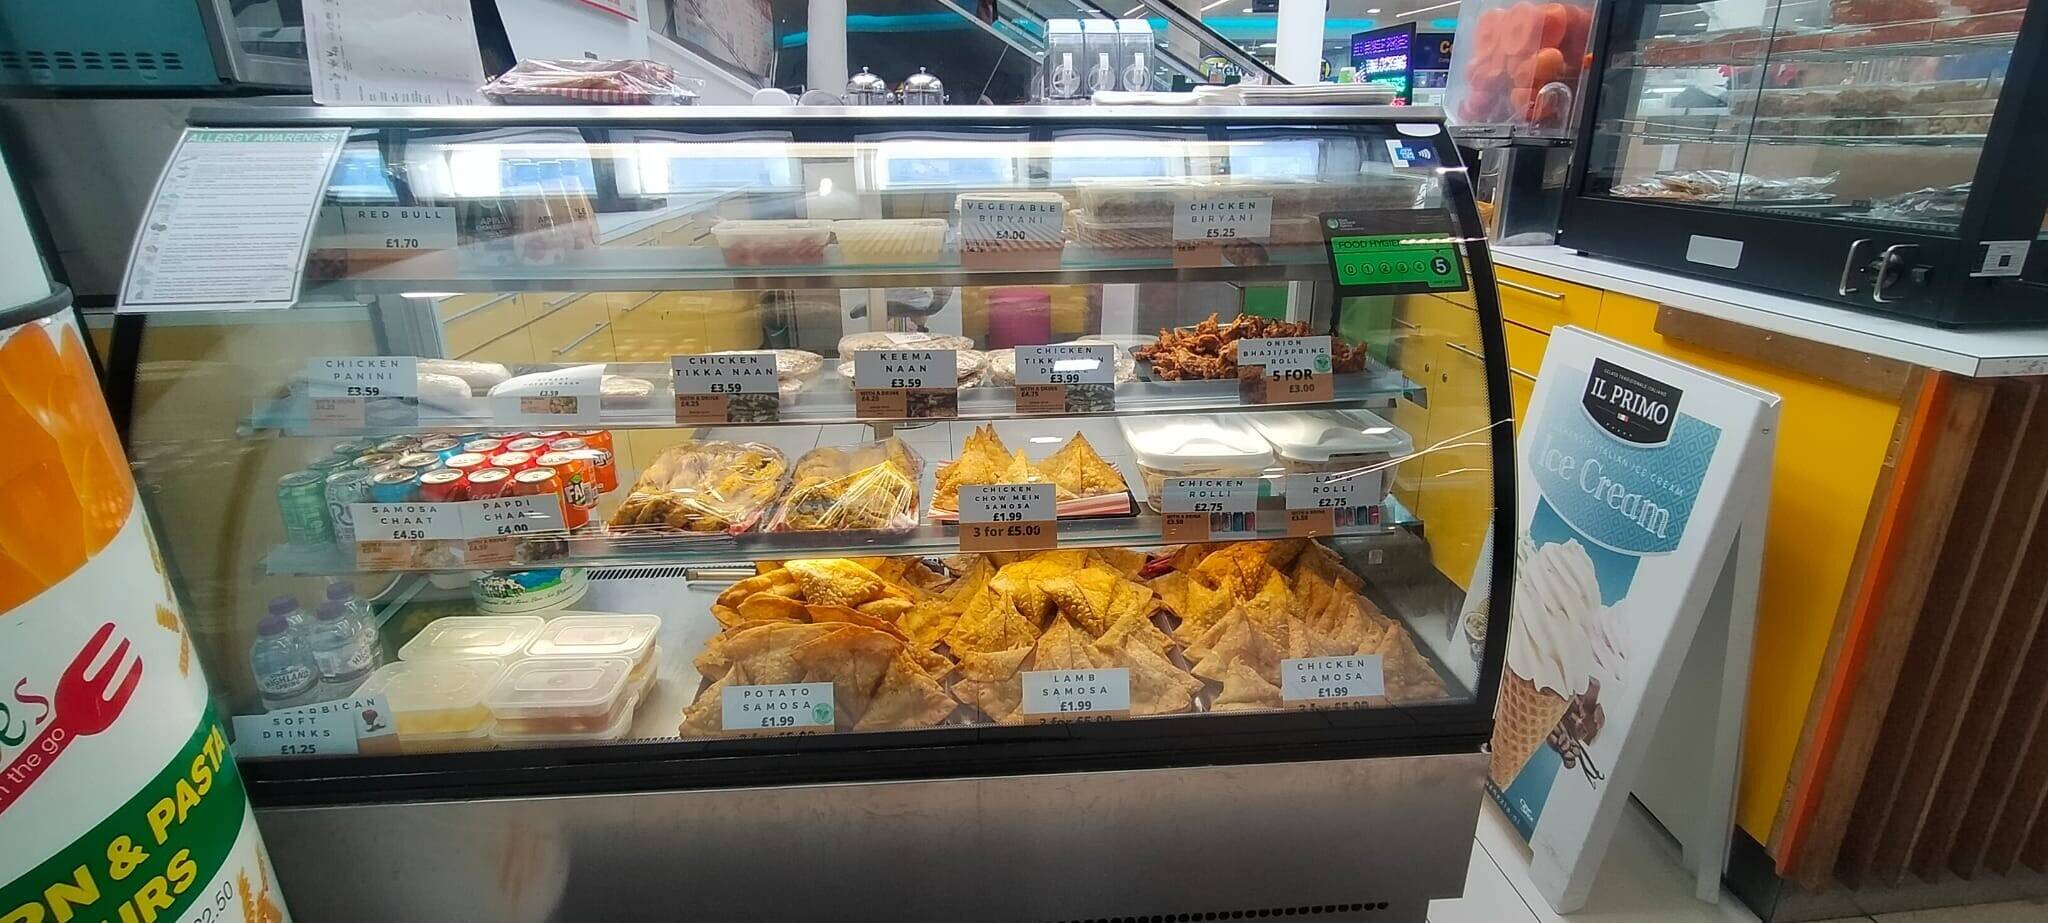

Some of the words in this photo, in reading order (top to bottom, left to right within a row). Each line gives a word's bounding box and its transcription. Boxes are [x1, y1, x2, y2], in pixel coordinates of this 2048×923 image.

[188, 132, 254, 143] ALLERGY
[254, 132, 338, 143] AWARENESS
[967, 202, 1057, 213] VEGETABLE
[1190, 202, 1256, 211] CHICKEN
[359, 211, 391, 219] RED
[400, 211, 442, 219] BULL
[979, 214, 1045, 224] BIRYANI
[1191, 214, 1254, 223] BIRYANI
[1206, 228, 1236, 238] £5.25
[386, 238, 419, 248] £1.70
[1338, 240, 1367, 248] FOOD
[1370, 238, 1409, 247] HYGIE
[1435, 259, 1447, 273] 5
[1243, 348, 1325, 357] BHAJI/SPRING
[326, 360, 399, 368] CHICKEN
[689, 357, 758, 365] CHICKEN
[733, 368, 773, 376] NAAN
[886, 365, 927, 373] NAAN
[1050, 374, 1080, 383] £3.99
[1273, 370, 1280, 381] 5
[1285, 369, 1313, 381] FOR
[711, 384, 742, 393] £3.59
[891, 379, 922, 388] £3.59
[1289, 384, 1315, 393] £3.00
[347, 387, 380, 396] £3.59
[1590, 377, 1607, 400] IL
[1609, 385, 1669, 425] PRIMO
[1631, 464, 1648, 477] ICE
[1650, 474, 1685, 497] CREAM
[1313, 485, 1354, 493] ROLLI
[1538, 435, 1576, 480] Ice
[1580, 458, 1669, 539] Cream
[483, 499, 531, 510] PAPDI
[1195, 503, 1223, 511] £2.75
[1319, 498, 1347, 506] £2.75
[993, 512, 1022, 521] £1.99
[393, 530, 425, 539] £4.50
[497, 524, 529, 535] £4.00
[973, 527, 981, 537] 3
[984, 527, 1004, 537] for
[1007, 525, 1041, 536] £5.00
[1297, 660, 1364, 670] CHICKEN
[1054, 674, 1095, 682] LAMB
[1301, 673, 1362, 683] SAMOSA
[744, 688, 809, 698] POTATO
[1043, 686, 1107, 696] SAMOSA
[1319, 687, 1348, 697] £1.99
[283, 699, 375, 714] RBICAN
[743, 701, 811, 711] SAMOSA
[1060, 701, 1092, 711] £1.99
[273, 717, 316, 725] SOFT
[761, 716, 795, 727] £1.99
[263, 730, 330, 738] DRINKS
[281, 744, 316, 754] £1.25
[7, 753, 42, 783] the
[42, 728, 65, 754] go
[107, 835, 150, 880] &
[147, 724, 226, 845] PASTA
